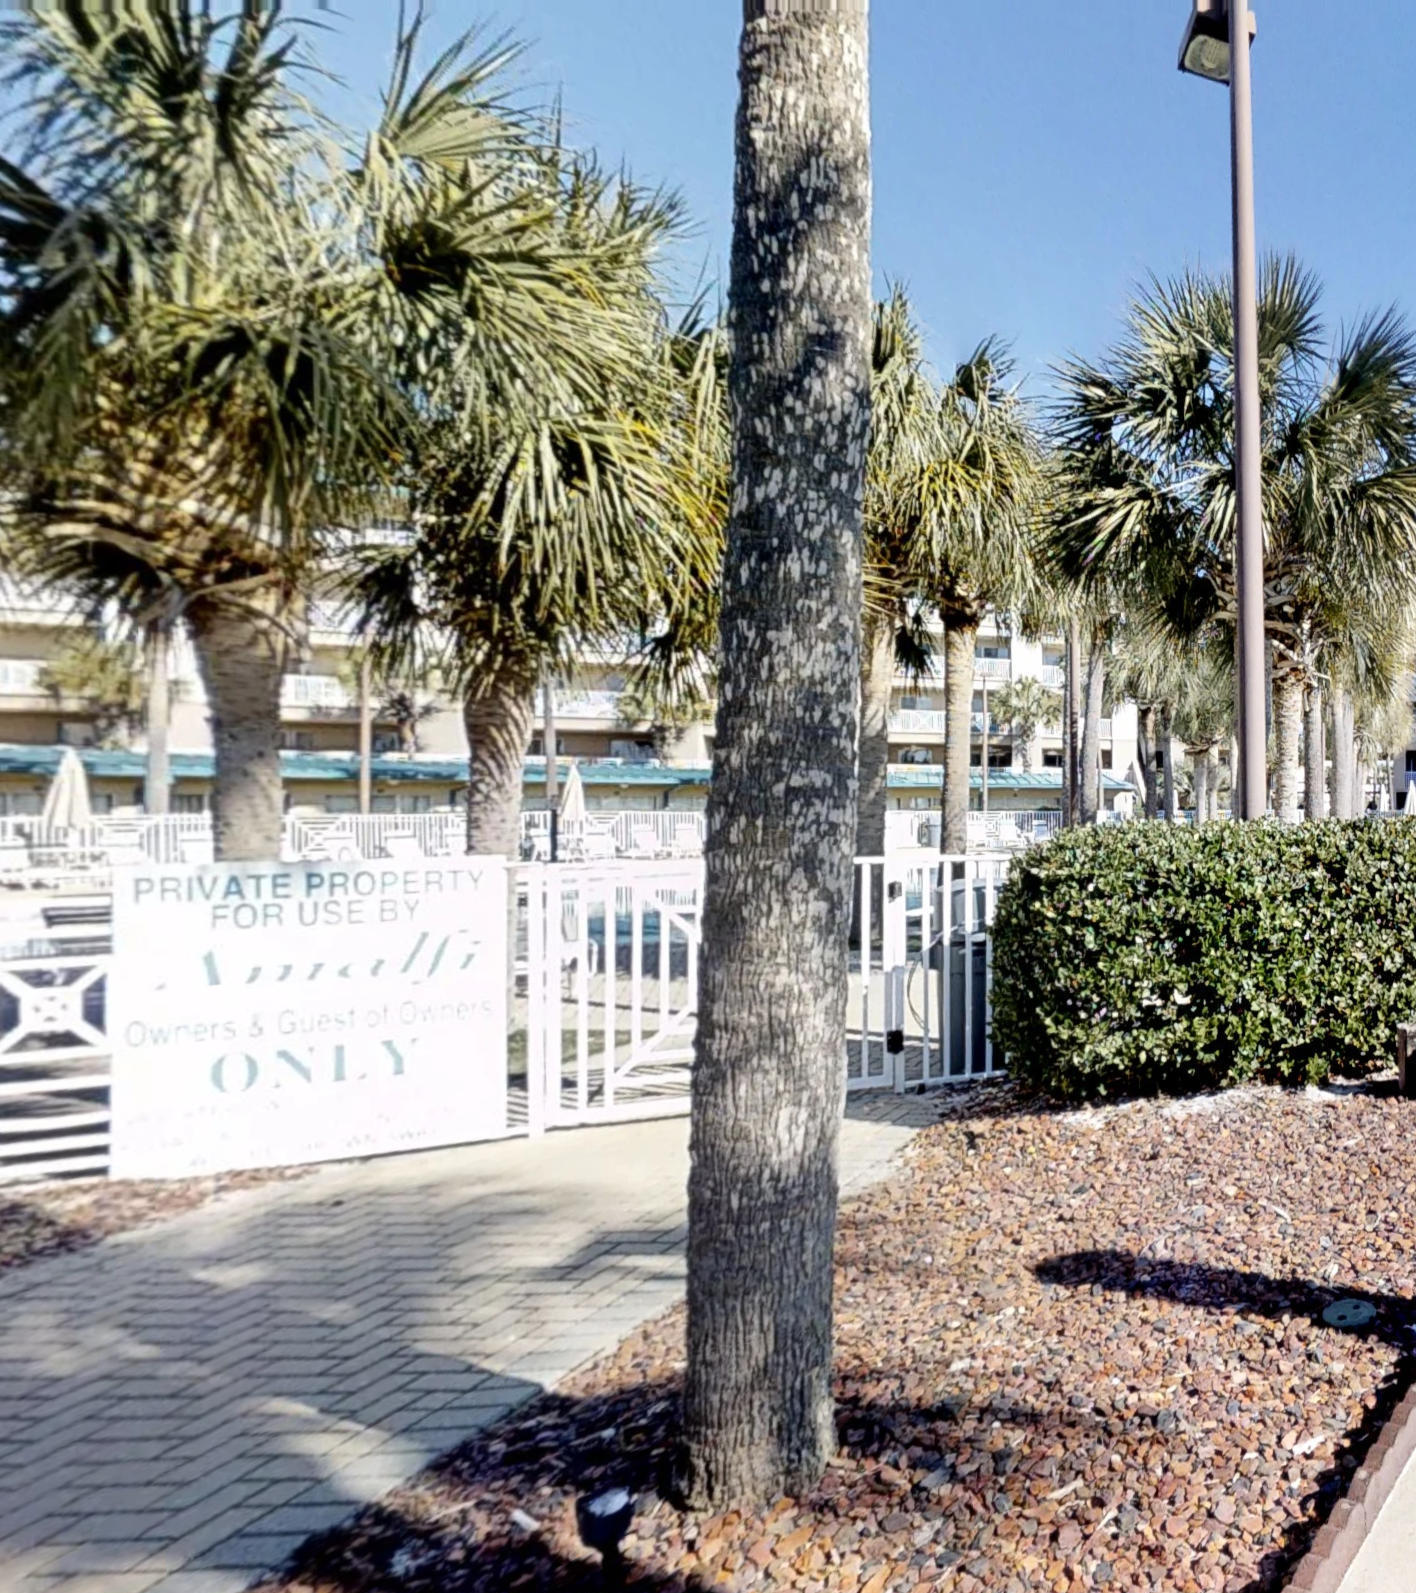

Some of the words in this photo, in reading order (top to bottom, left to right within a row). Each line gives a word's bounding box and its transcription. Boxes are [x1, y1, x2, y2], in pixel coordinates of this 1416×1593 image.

[133, 872, 293, 904] PRIVATE
[304, 868, 485, 899] PROPERTY
[211, 903, 284, 929] FOR
[297, 899, 364, 927] USE
[379, 898, 420, 923] BY
[125, 1019, 236, 1048] Owners
[278, 1006, 357, 1036] Guest
[399, 997, 496, 1027] Owners
[208, 1036, 421, 1094] ONLY
